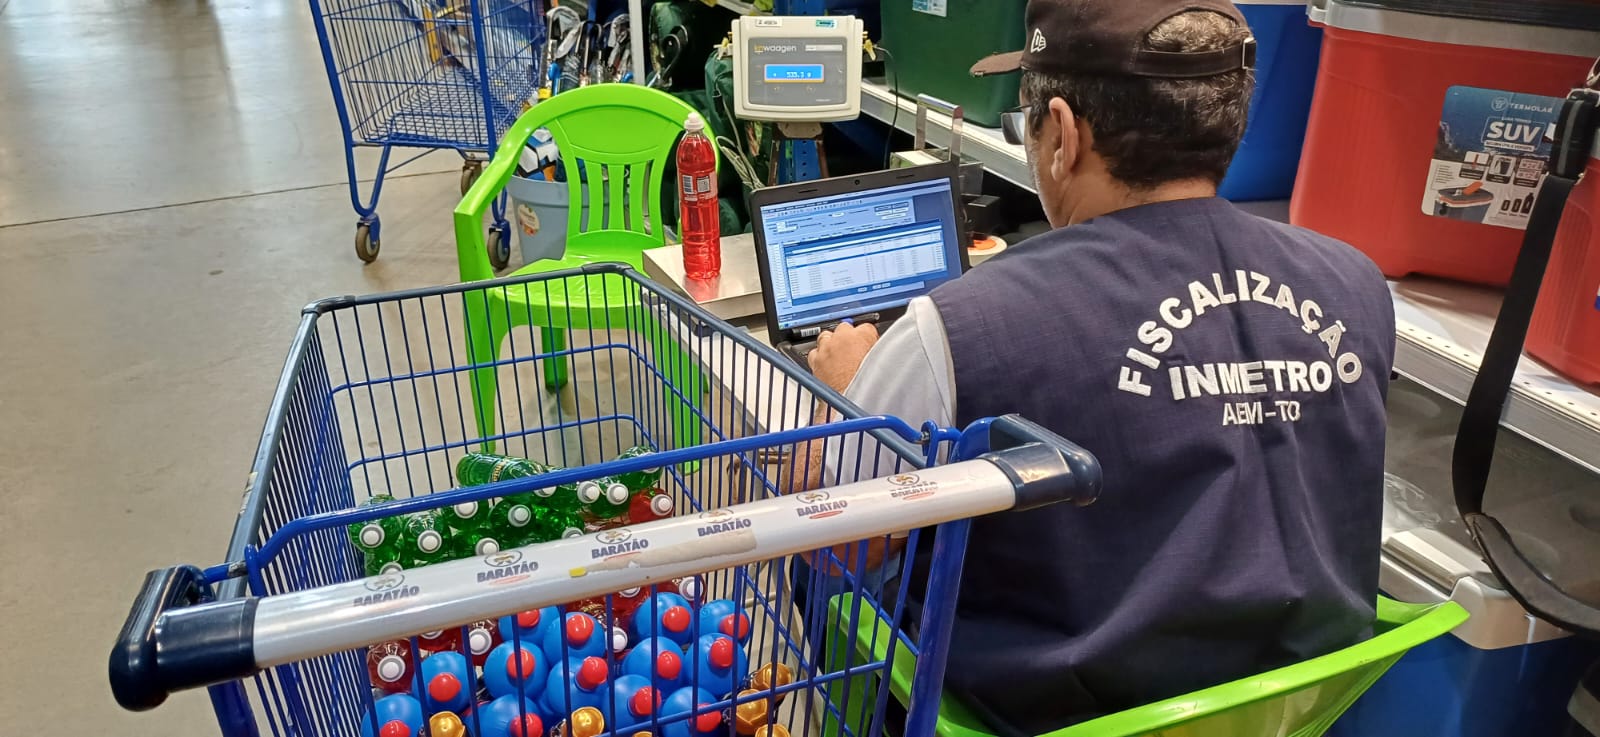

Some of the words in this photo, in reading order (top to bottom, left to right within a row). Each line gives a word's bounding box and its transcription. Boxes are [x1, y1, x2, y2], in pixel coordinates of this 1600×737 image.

[1509, 103, 1553, 113] TERMOLAR
[1487, 121, 1541, 143] SUV
[1118, 269, 1363, 397] FISCALIZAÇÃO
[1168, 360, 1333, 400] INMETRO
[697, 518, 752, 537] BARATÃO
[591, 538, 649, 559] BARATÃO
[477, 561, 539, 583] BARATÃO
[353, 585, 420, 607] BARATÃO
